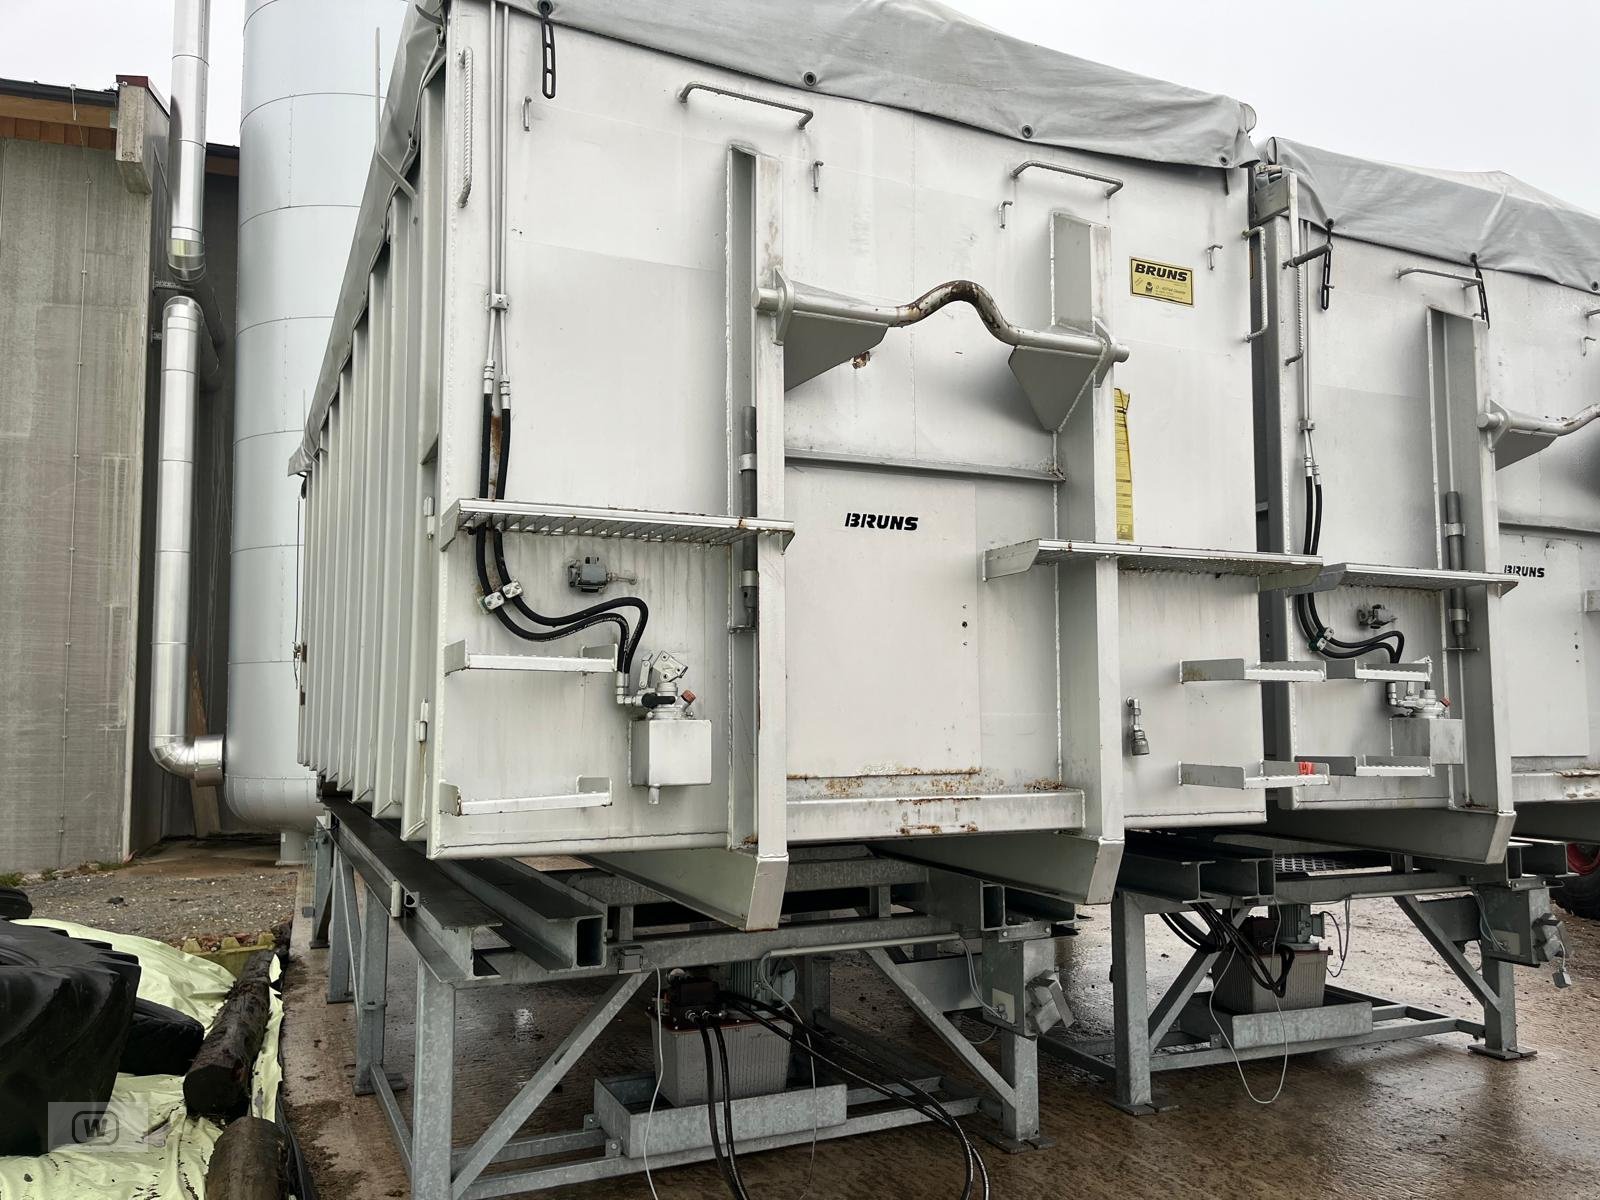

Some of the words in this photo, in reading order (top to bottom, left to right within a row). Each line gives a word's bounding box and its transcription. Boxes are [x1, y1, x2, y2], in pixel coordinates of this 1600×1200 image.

[1134, 263, 1188, 281] BRUNS
[845, 513, 919, 531] BRUNS
[1503, 565, 1545, 578] BRUNS
